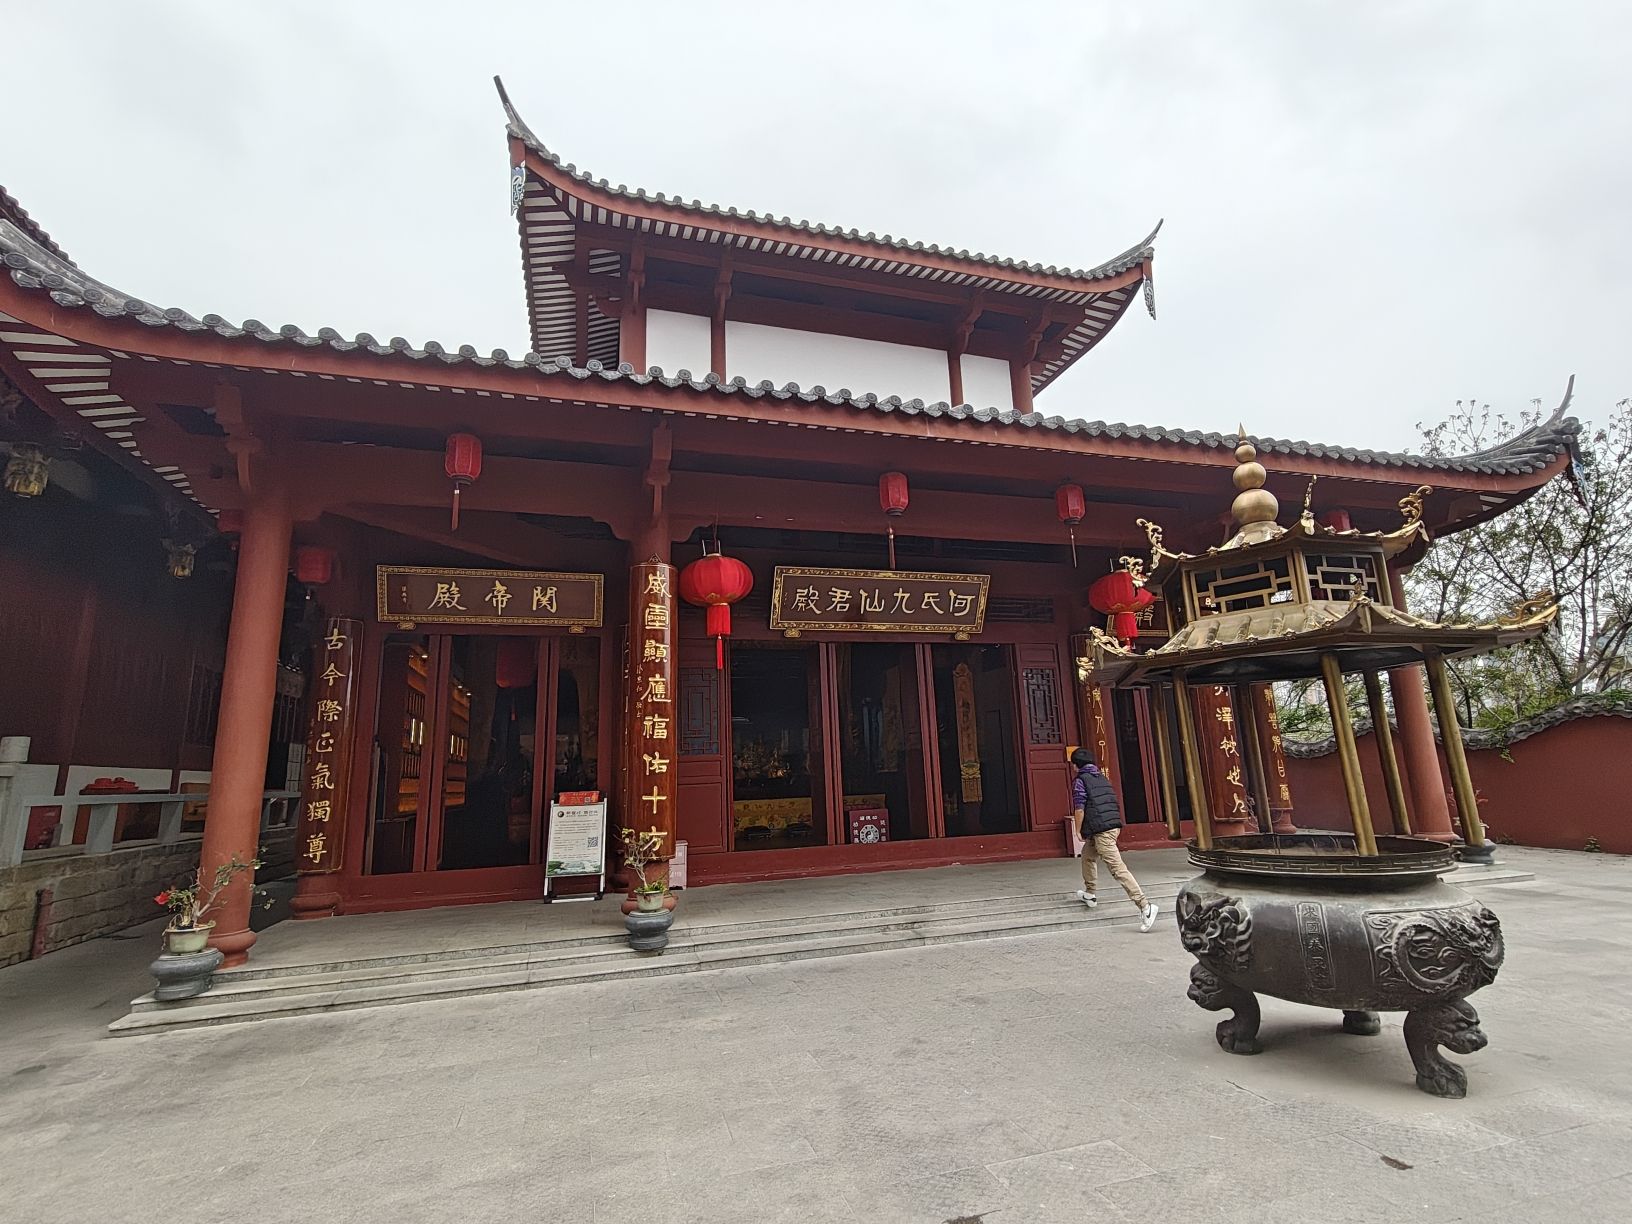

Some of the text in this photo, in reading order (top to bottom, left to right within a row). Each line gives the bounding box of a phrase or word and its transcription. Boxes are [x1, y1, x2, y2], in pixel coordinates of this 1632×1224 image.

[790, 585, 976, 617] 何氏九仙君殿
